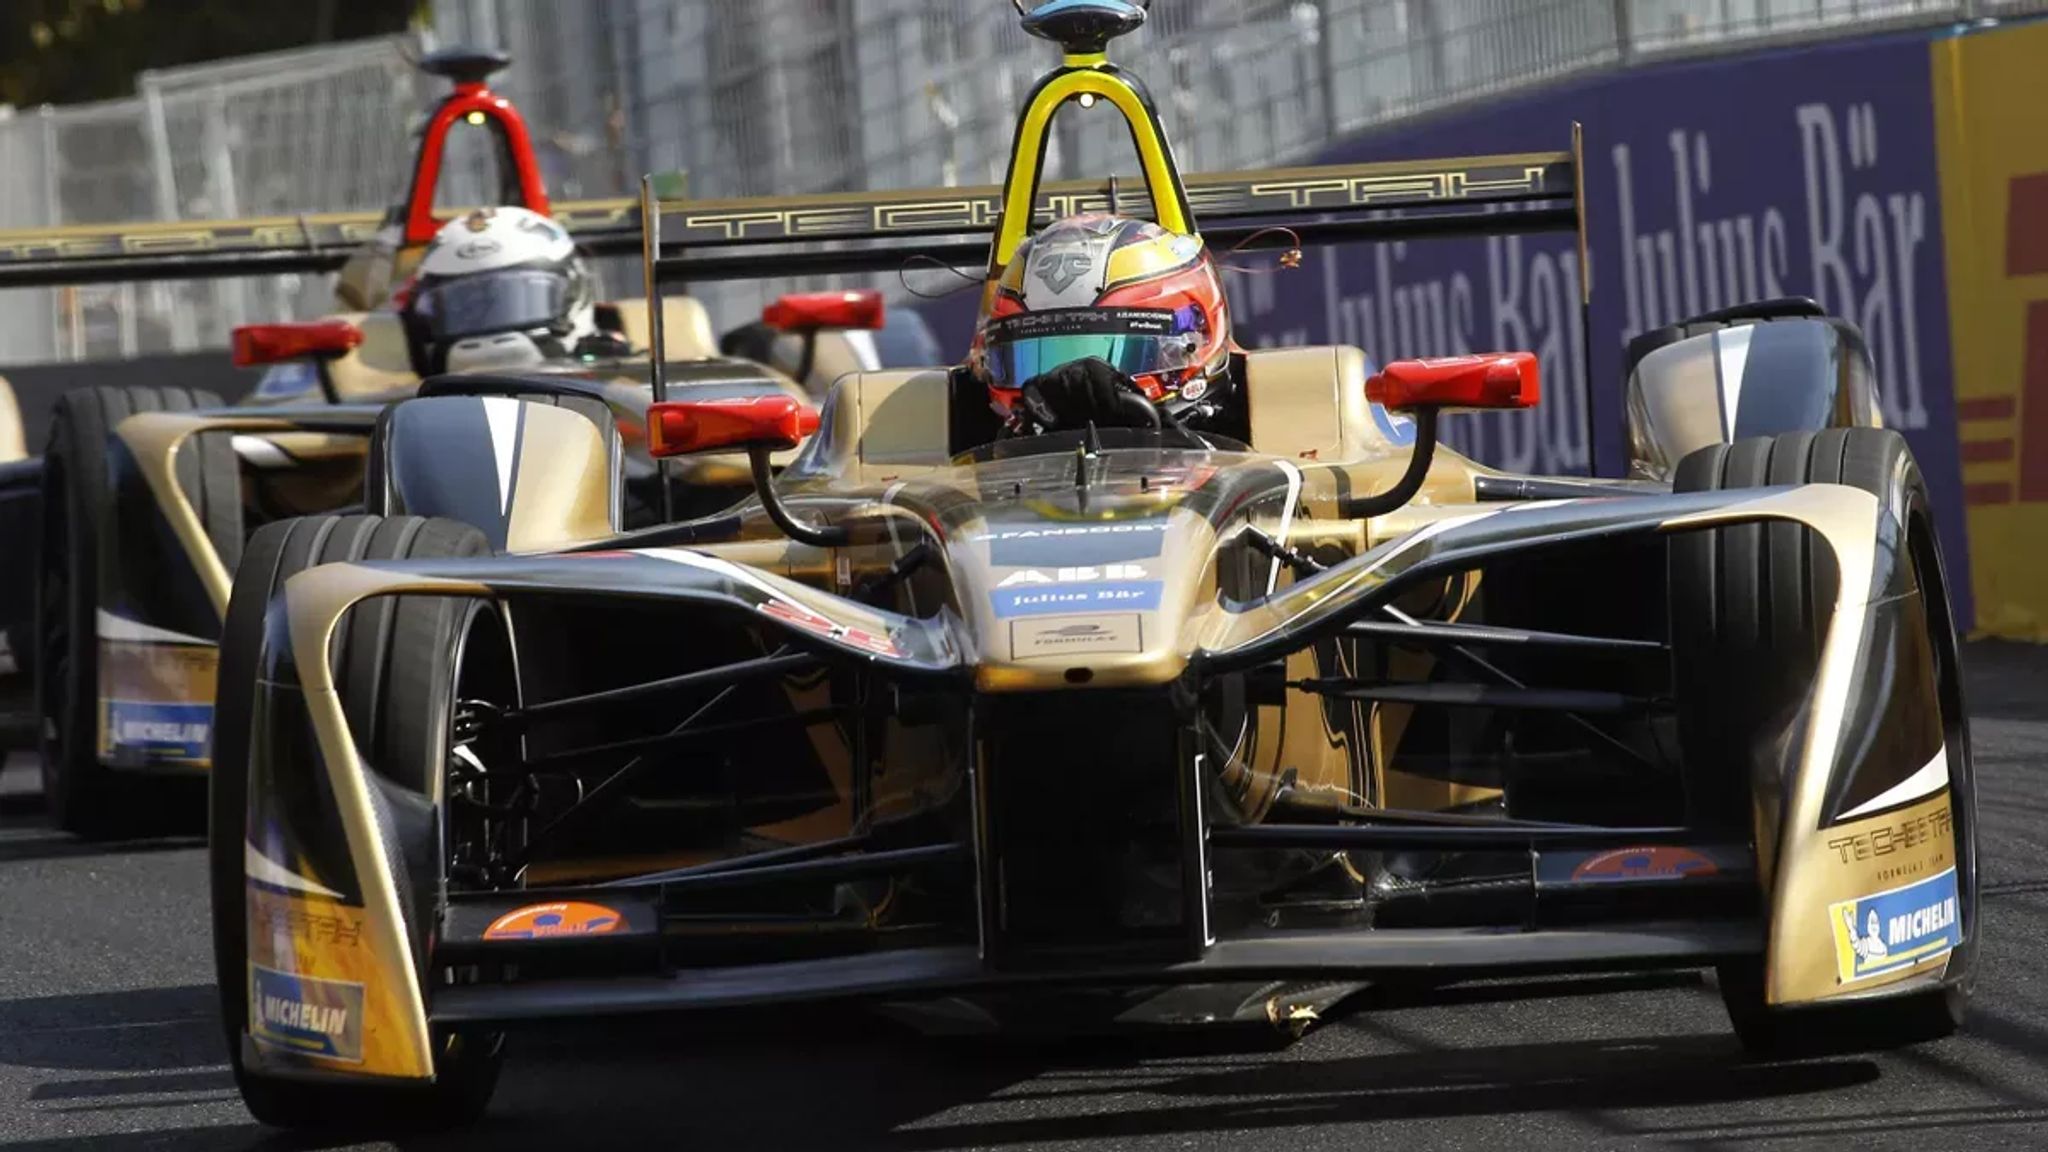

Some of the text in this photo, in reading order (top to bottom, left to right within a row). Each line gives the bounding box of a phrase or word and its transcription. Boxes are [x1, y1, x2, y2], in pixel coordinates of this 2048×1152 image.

[1612, 128, 1790, 350] Julius
[1797, 102, 1928, 428] Bär
[996, 565, 1148, 588] ABB
[1013, 592, 1088, 606] Julius
[1827, 806, 1952, 865] TECHEETA
[1888, 897, 1955, 945] MICHELIN
[265, 995, 348, 1035] MICHELIN
